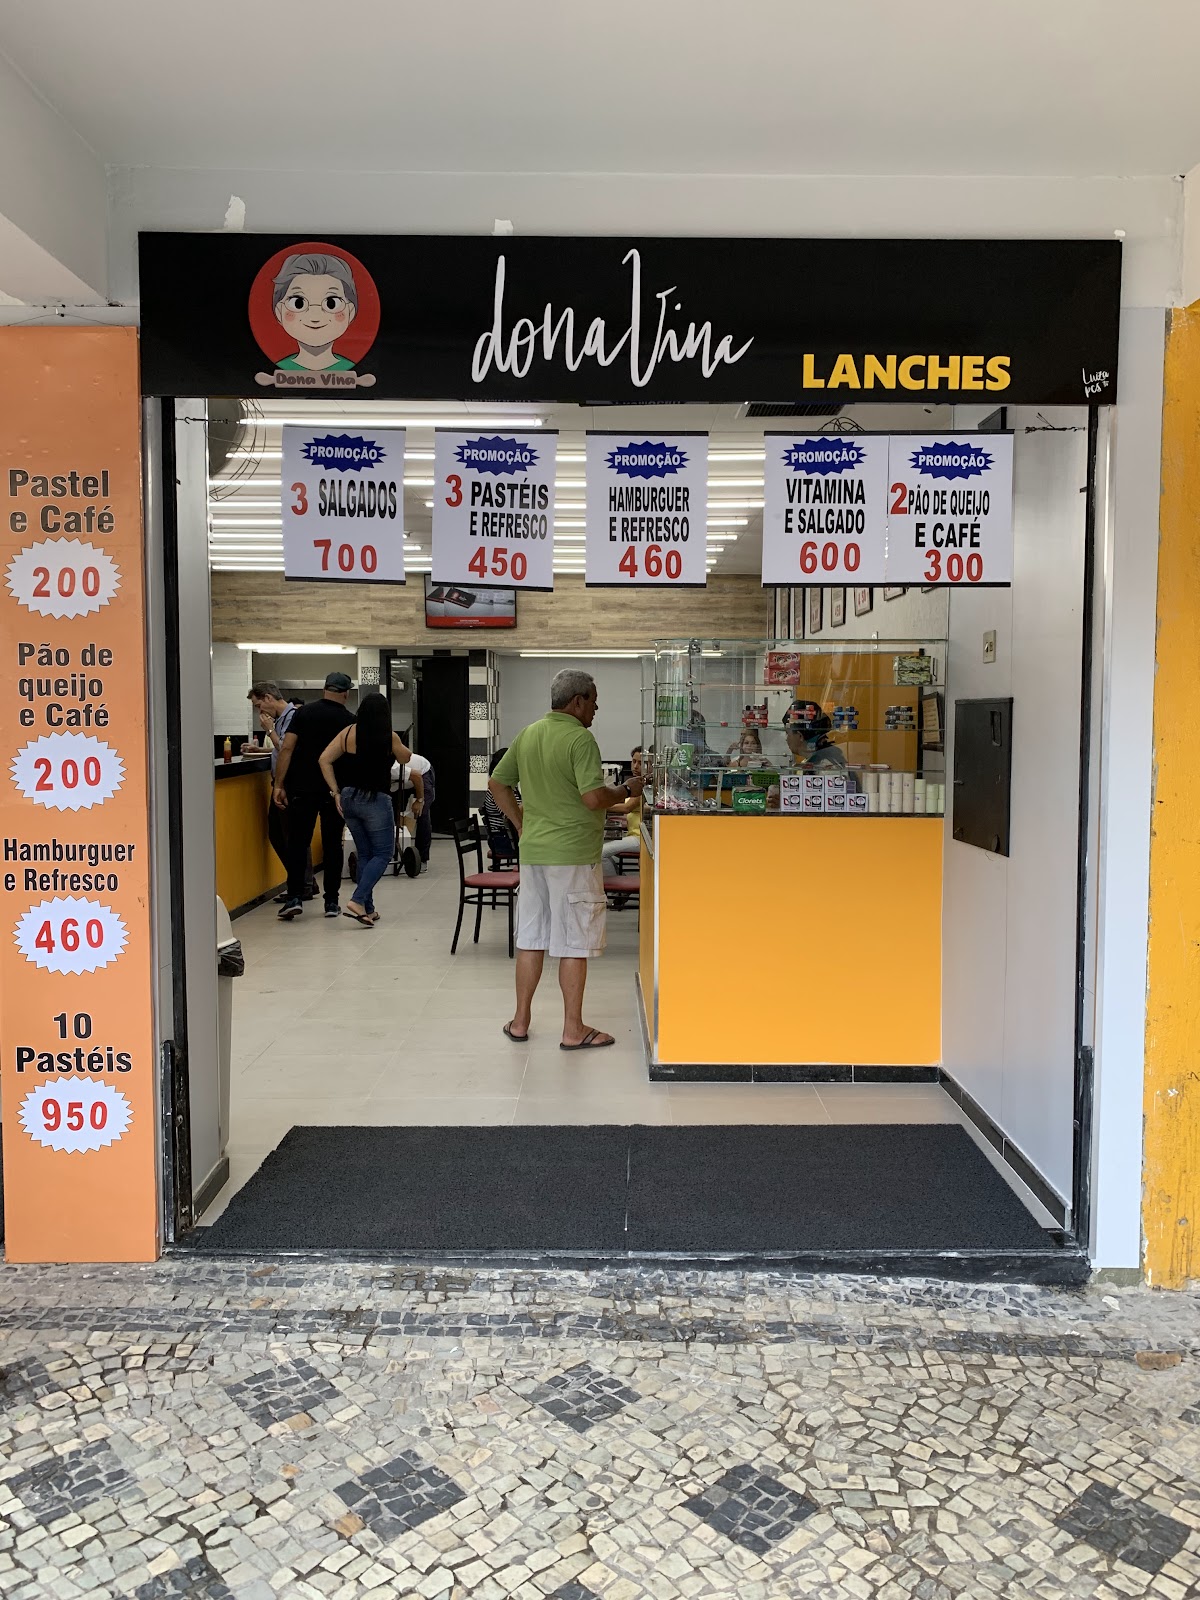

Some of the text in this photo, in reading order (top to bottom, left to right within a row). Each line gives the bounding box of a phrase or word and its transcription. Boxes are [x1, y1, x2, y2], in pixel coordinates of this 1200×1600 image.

[472, 247, 754, 387] dona Vina
[276, 373, 356, 385] Dona Vina
[803, 354, 1011, 390] LANCHES
[309, 443, 378, 463] PROMOÇÃO
[463, 446, 531, 466] PROMOÇÃO
[614, 452, 681, 468] PROMOÇÃO
[791, 448, 858, 465] PROMOÇÃO
[918, 452, 985, 470] PROMOÇÃO
[9, 469, 109, 498] Pastel
[445, 474, 549, 510] 3 PASTÉIS
[786, 479, 866, 505] VITAMINA
[291, 478, 397, 520] 3 SALGADOS
[609, 486, 690, 512] HAMBURGUER
[890, 482, 990, 517] 2 PÃO DE QUEIJO
[10, 505, 115, 534] e Café
[469, 511, 548, 540] E REFRESCO
[609, 516, 689, 542] E REFRESCO
[784, 509, 866, 535] E SALGADO
[915, 516, 981, 548] E CAFÉ
[314, 539, 377, 573] 700
[468, 546, 528, 580] 450
[619, 544, 682, 579] 460
[800, 541, 861, 574] 600
[924, 549, 983, 582] 300
[32, 566, 100, 598] 200
[18, 642, 113, 667] Pão de
[18, 673, 103, 701] queijo
[19, 703, 110, 727] e Café
[34, 756, 102, 791] 200
[3, 838, 136, 867] Hamburguer
[4, 868, 119, 892] e Refresco
[35, 918, 104, 954] 460
[53, 1012, 93, 1039] 10
[16, 1045, 133, 1074] Pastéis
[41, 1098, 109, 1132] 950
